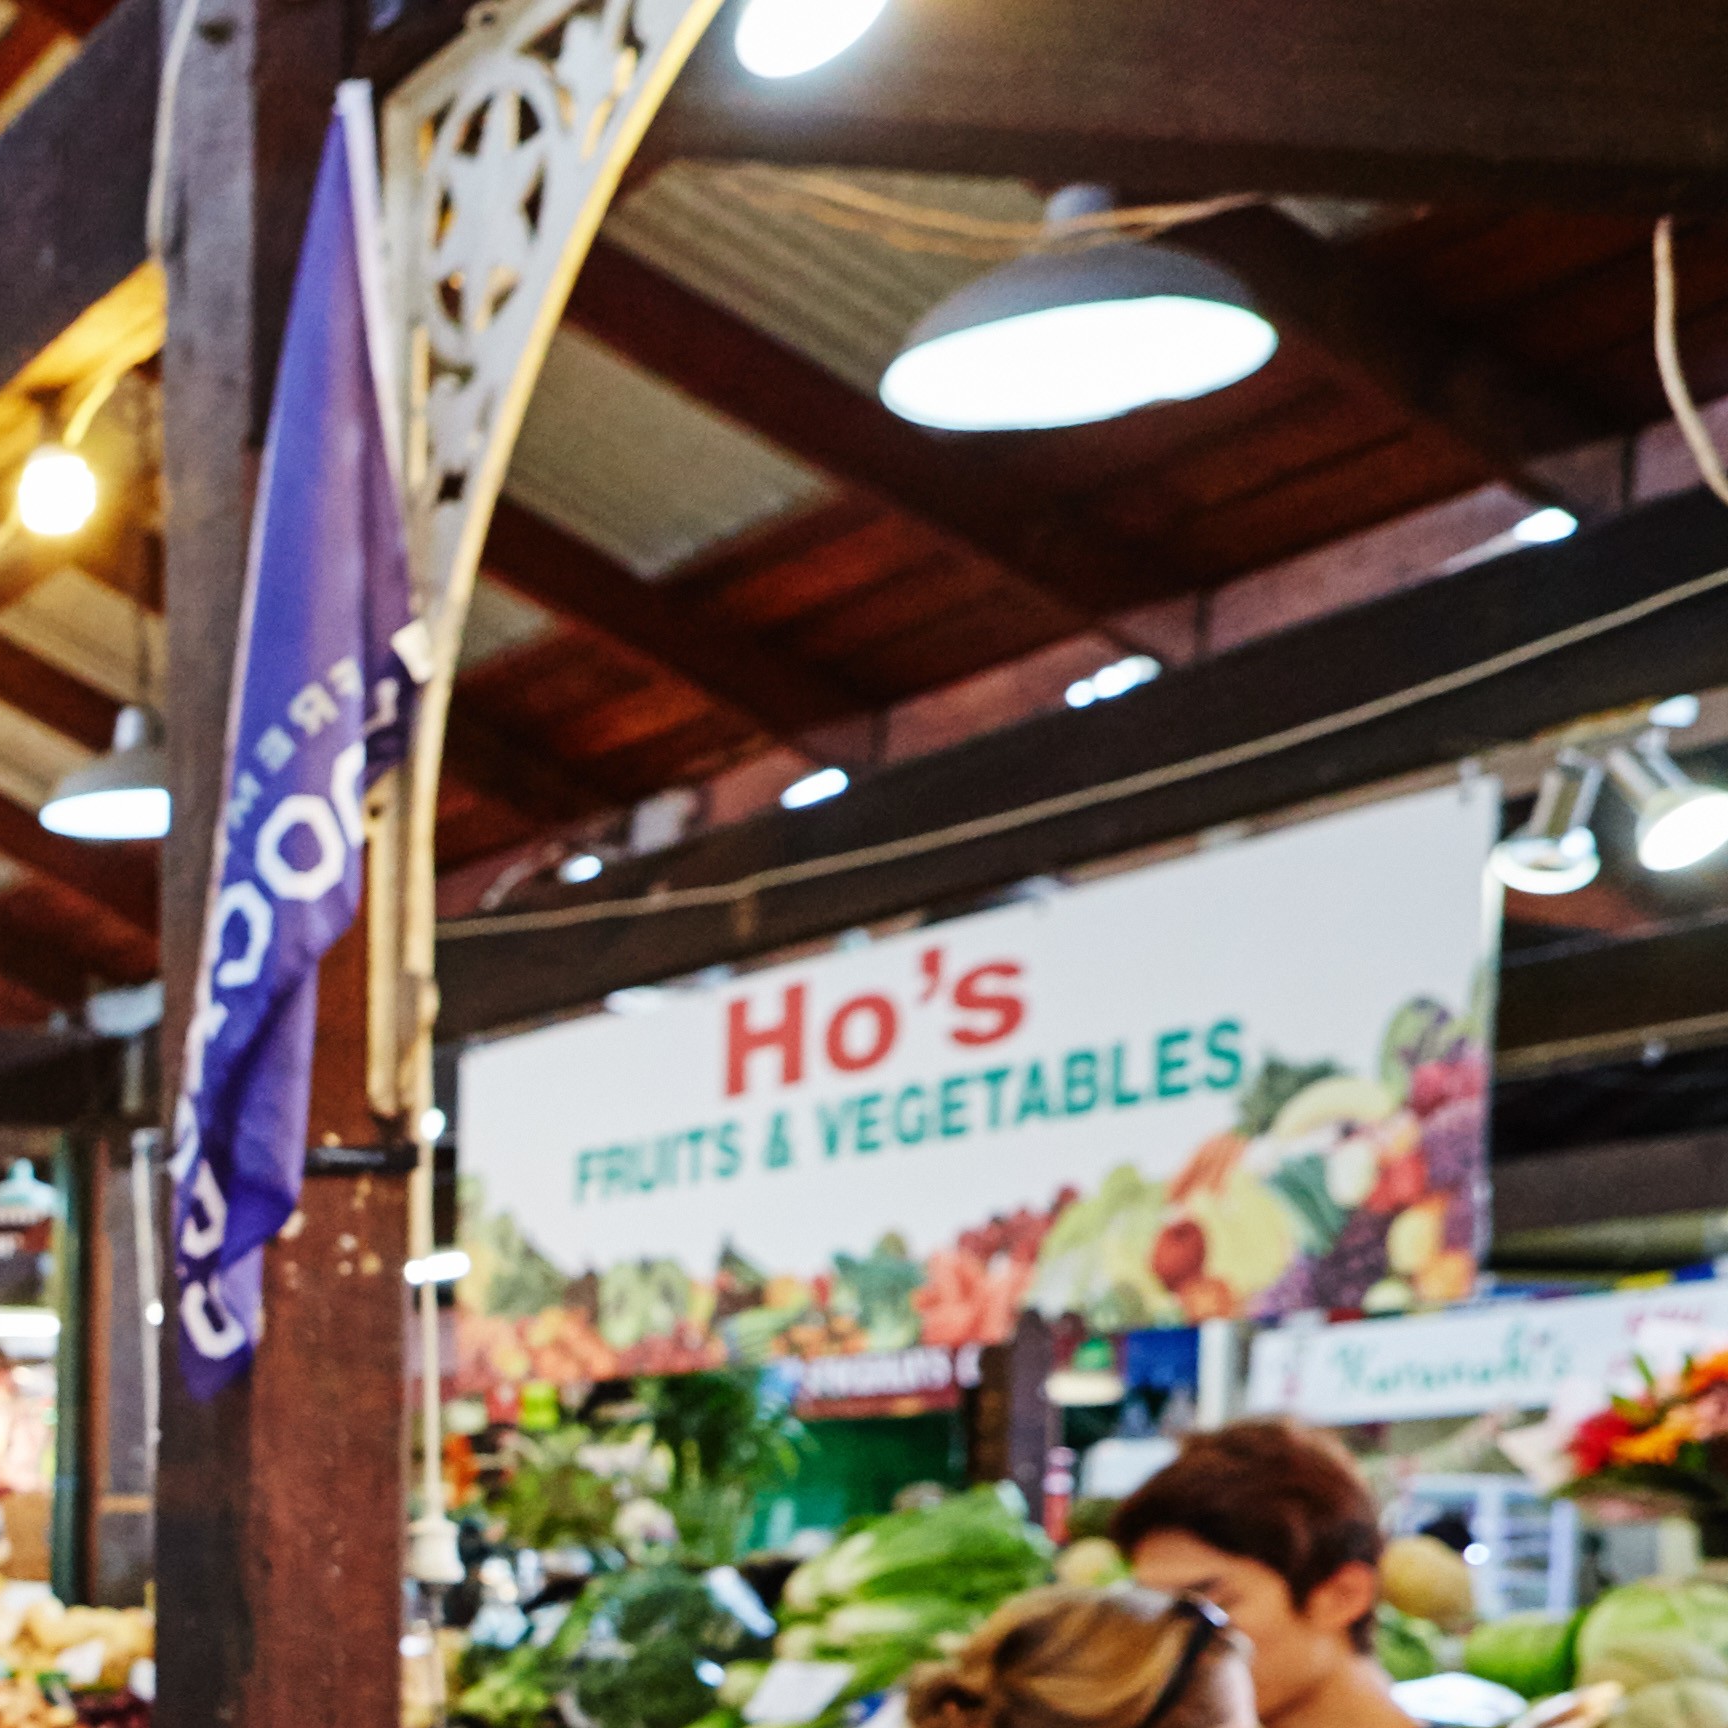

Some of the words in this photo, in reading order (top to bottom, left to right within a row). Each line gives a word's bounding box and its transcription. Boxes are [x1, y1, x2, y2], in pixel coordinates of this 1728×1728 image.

[724, 946, 1026, 1098] Ho's
[573, 1118, 742, 1207] FRUITS
[762, 1108, 792, 1169] &
[816, 1015, 1243, 1157] VEGETABLES
